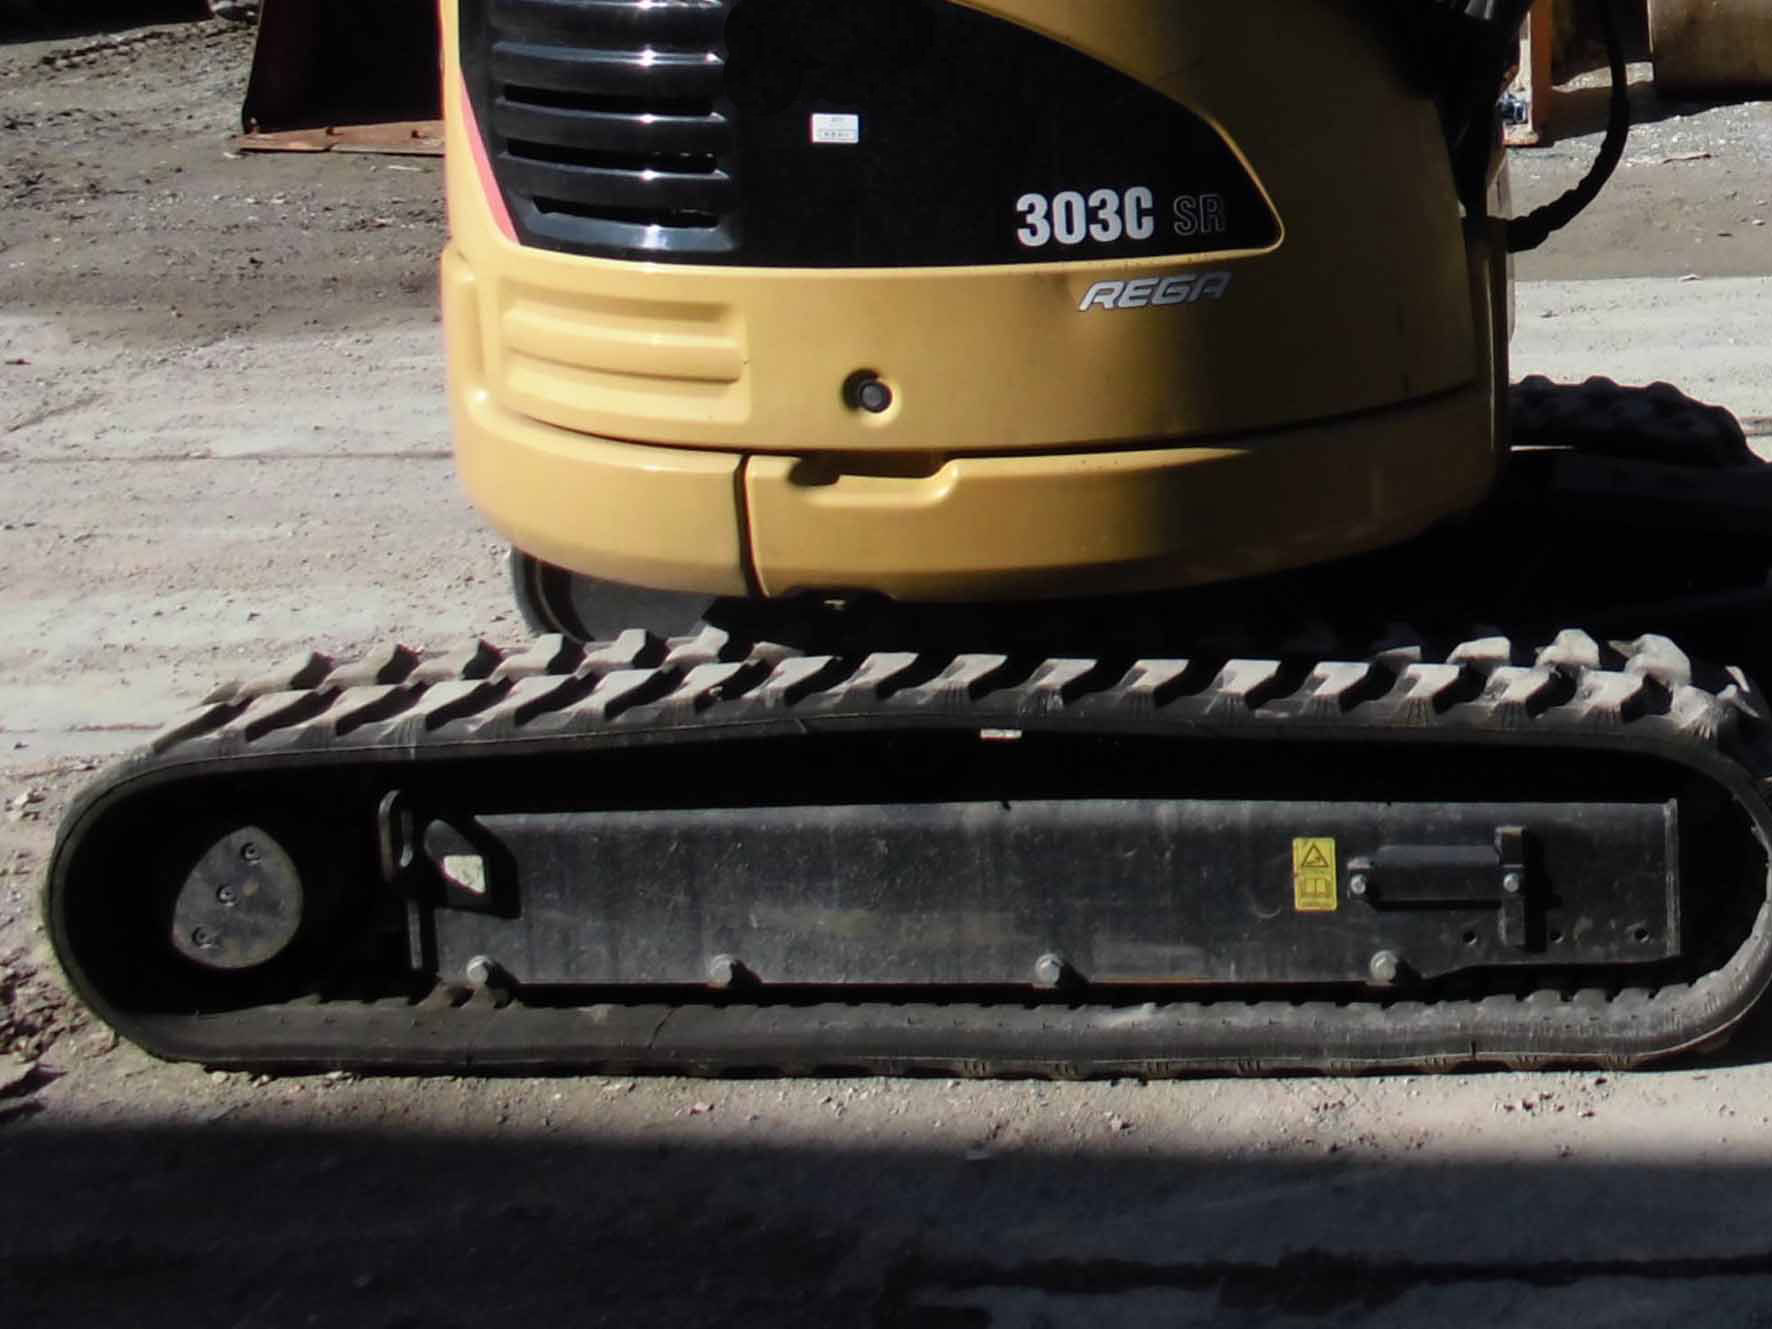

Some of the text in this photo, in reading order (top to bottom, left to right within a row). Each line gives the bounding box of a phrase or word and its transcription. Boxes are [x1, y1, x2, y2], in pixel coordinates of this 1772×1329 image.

[1016, 186, 1225, 247] 303C SR
[1078, 272, 1232, 311] REGA
